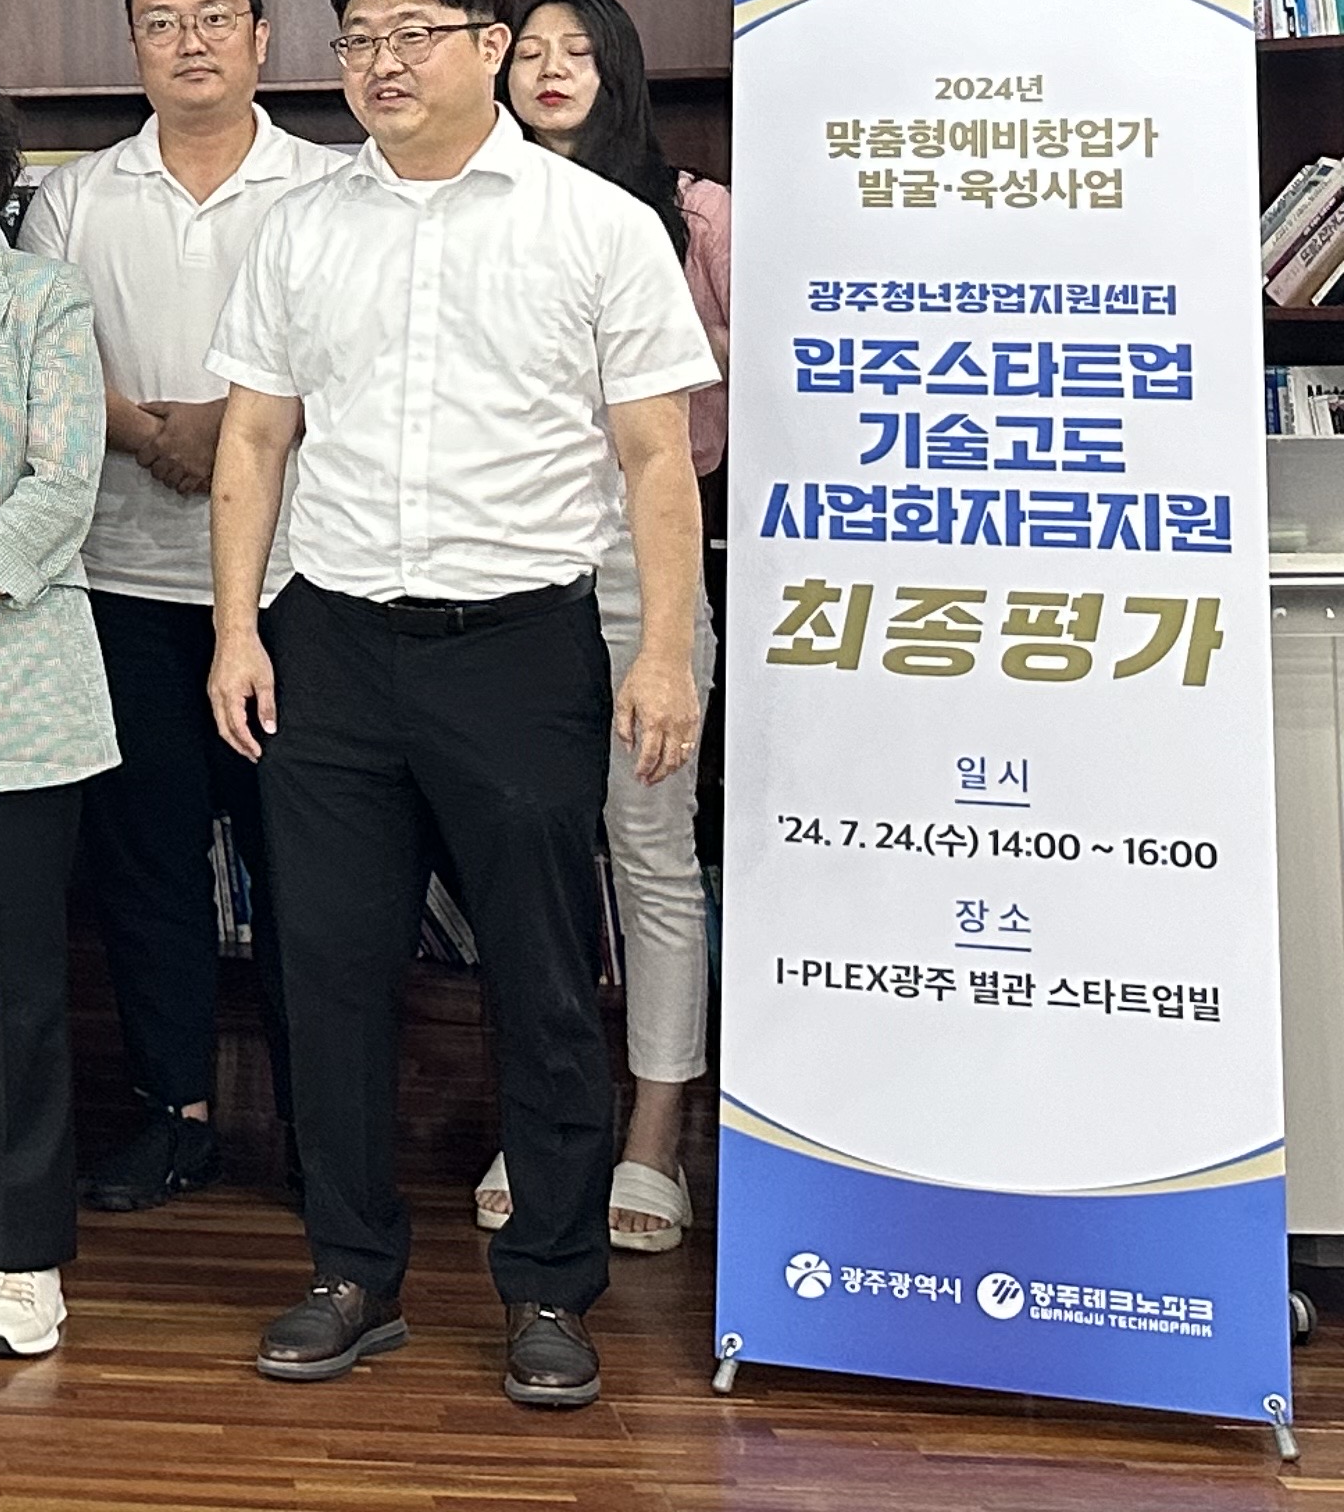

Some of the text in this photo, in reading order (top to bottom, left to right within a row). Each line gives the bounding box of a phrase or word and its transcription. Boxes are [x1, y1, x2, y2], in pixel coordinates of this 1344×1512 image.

[935, 75, 1043, 102] 2024년
[826, 118, 1158, 159] 맞춤형예비창업가
[859, 168, 1122, 209] 발굴·육성사업
[808, 281, 1176, 315] 광주청년창업지원센터
[793, 338, 1192, 400] 입주스타트업
[860, 413, 1125, 473] 기술고도
[760, 483, 1232, 553] 사업화자금지원
[766, 579, 1223, 687] 최종평가
[989, 830, 1080, 860] 14:00
[1123, 838, 1217, 869] 16:00
[777, 958, 1220, 1022] I-PLEX광주 별관 스타트업빌
[841, 1266, 1212, 1320] 광주광역시 광주테크노파크
